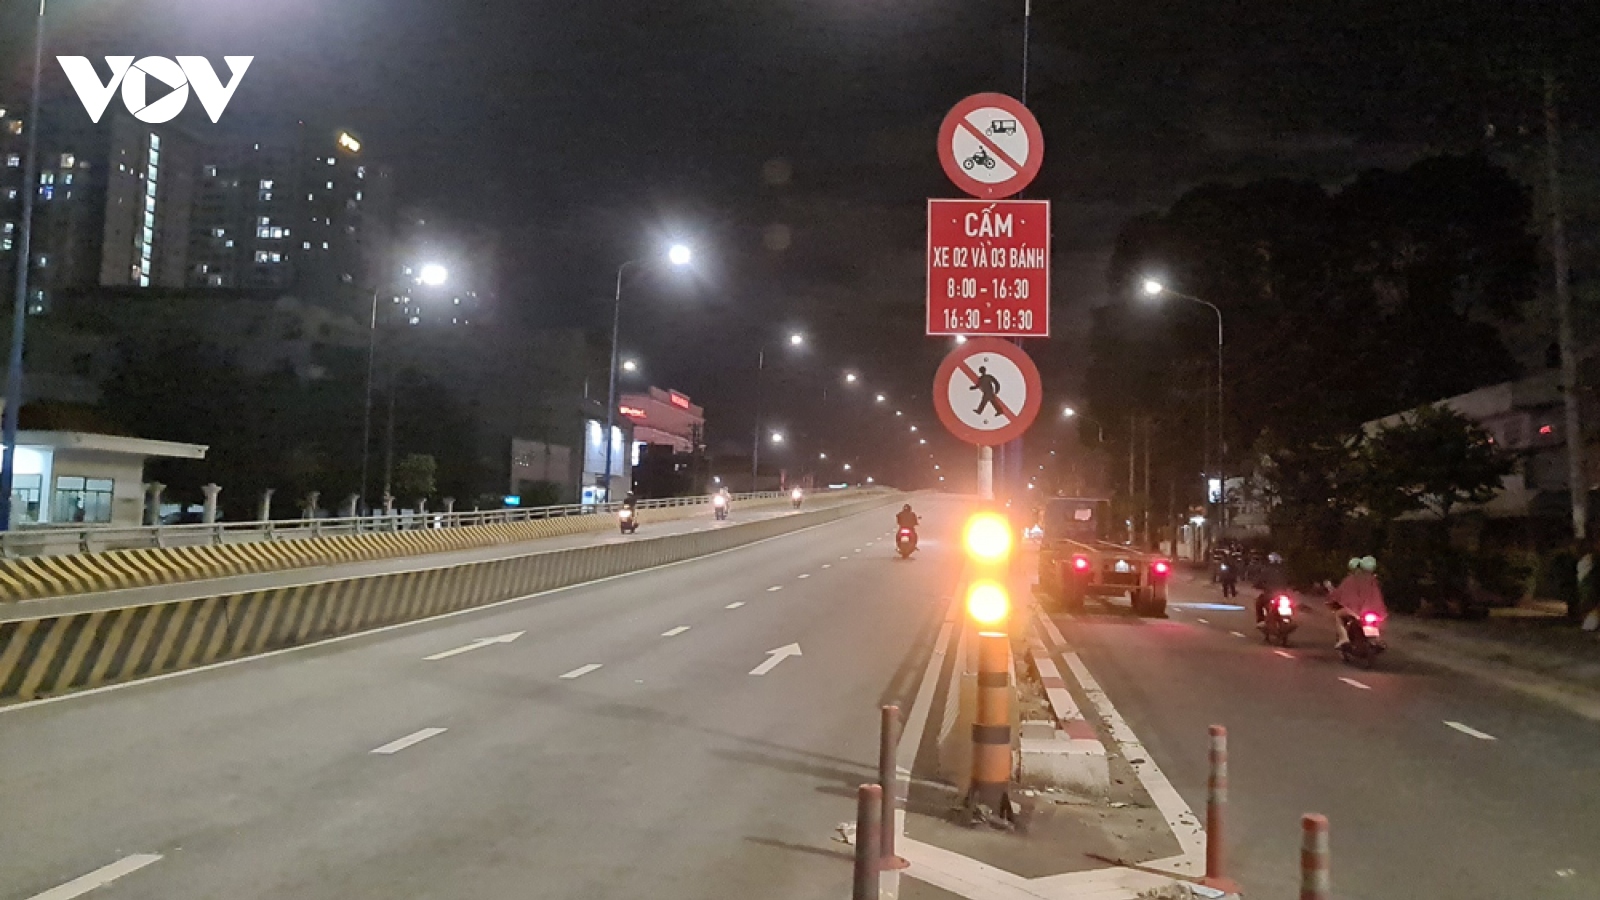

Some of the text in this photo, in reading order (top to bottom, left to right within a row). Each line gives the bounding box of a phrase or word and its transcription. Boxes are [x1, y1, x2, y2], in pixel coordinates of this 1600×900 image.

[964, 203, 1013, 237] CẤM
[933, 242, 1044, 269] XE 02 VÀ 03 BÁNH
[947, 278, 976, 298] 8:00
[992, 278, 1029, 299] 16:30
[943, 308, 980, 329] 16:30
[996, 309, 1033, 330] 18:30
